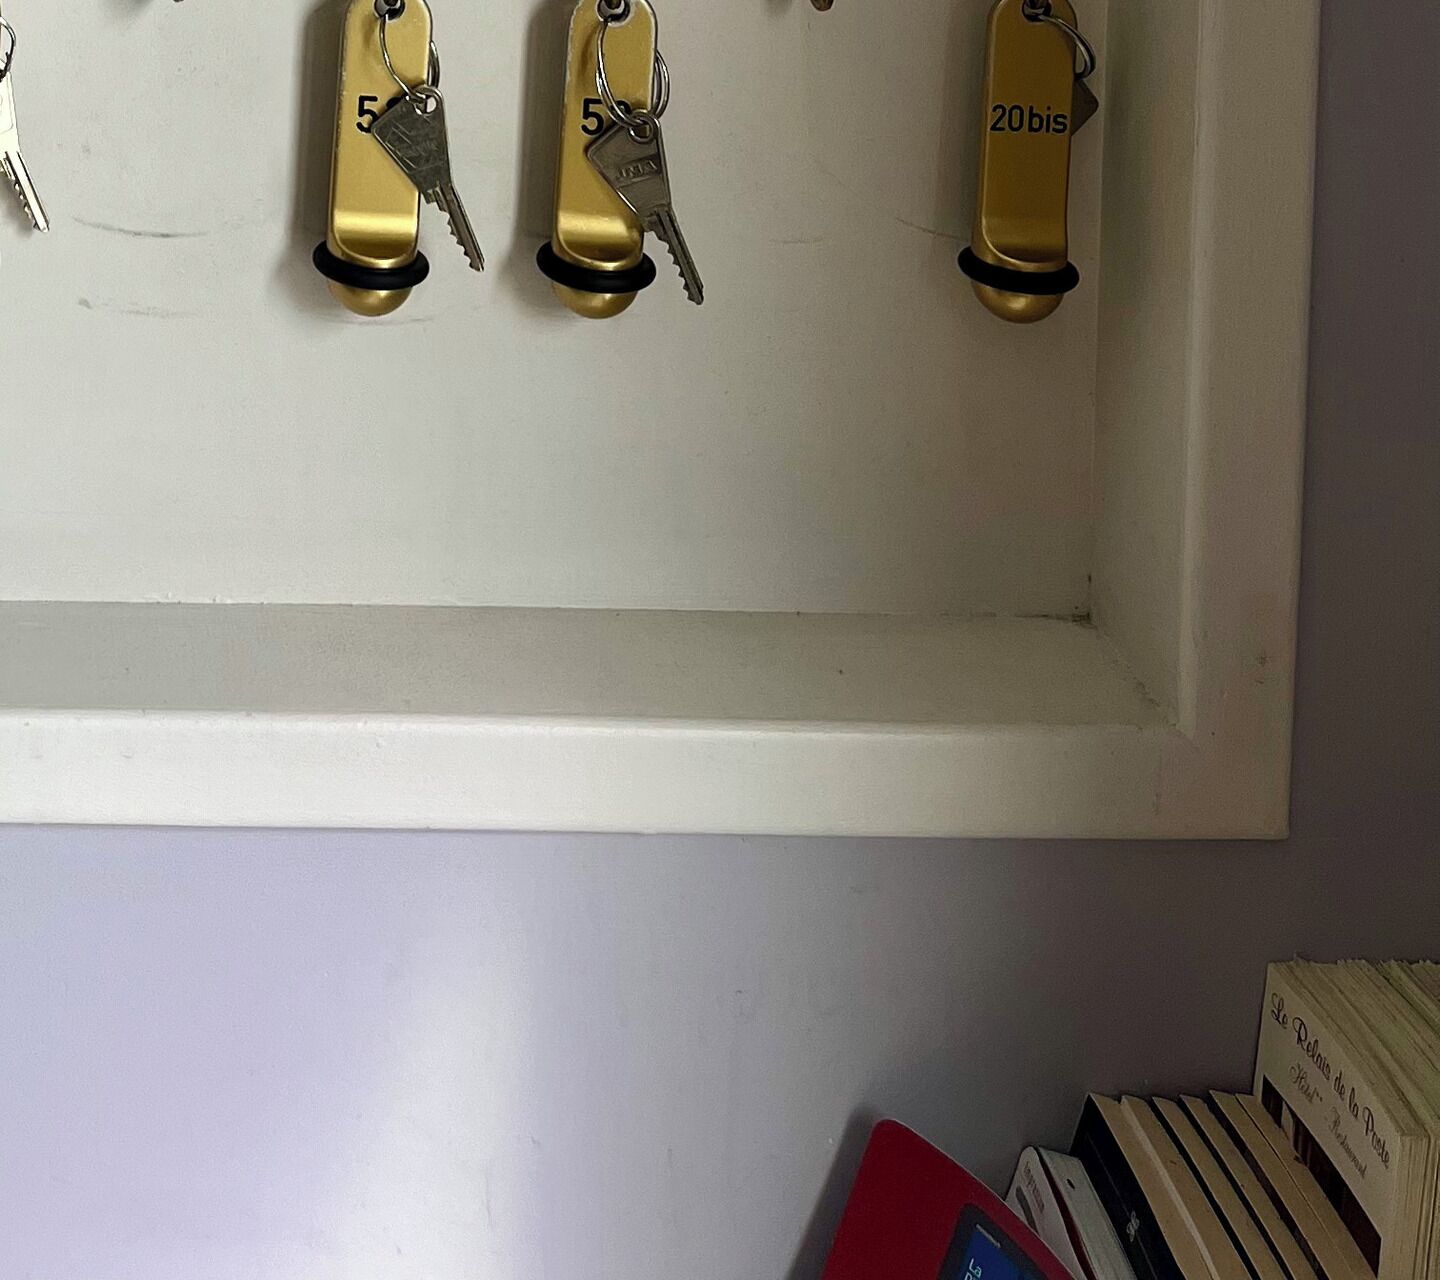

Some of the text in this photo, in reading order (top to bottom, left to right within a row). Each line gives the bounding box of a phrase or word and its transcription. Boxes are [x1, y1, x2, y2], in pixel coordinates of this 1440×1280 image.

[355, 94, 401, 135] 5
[989, 104, 1068, 136] 20bis
[1271, 992, 1390, 1169] Le Relais de la Poste
